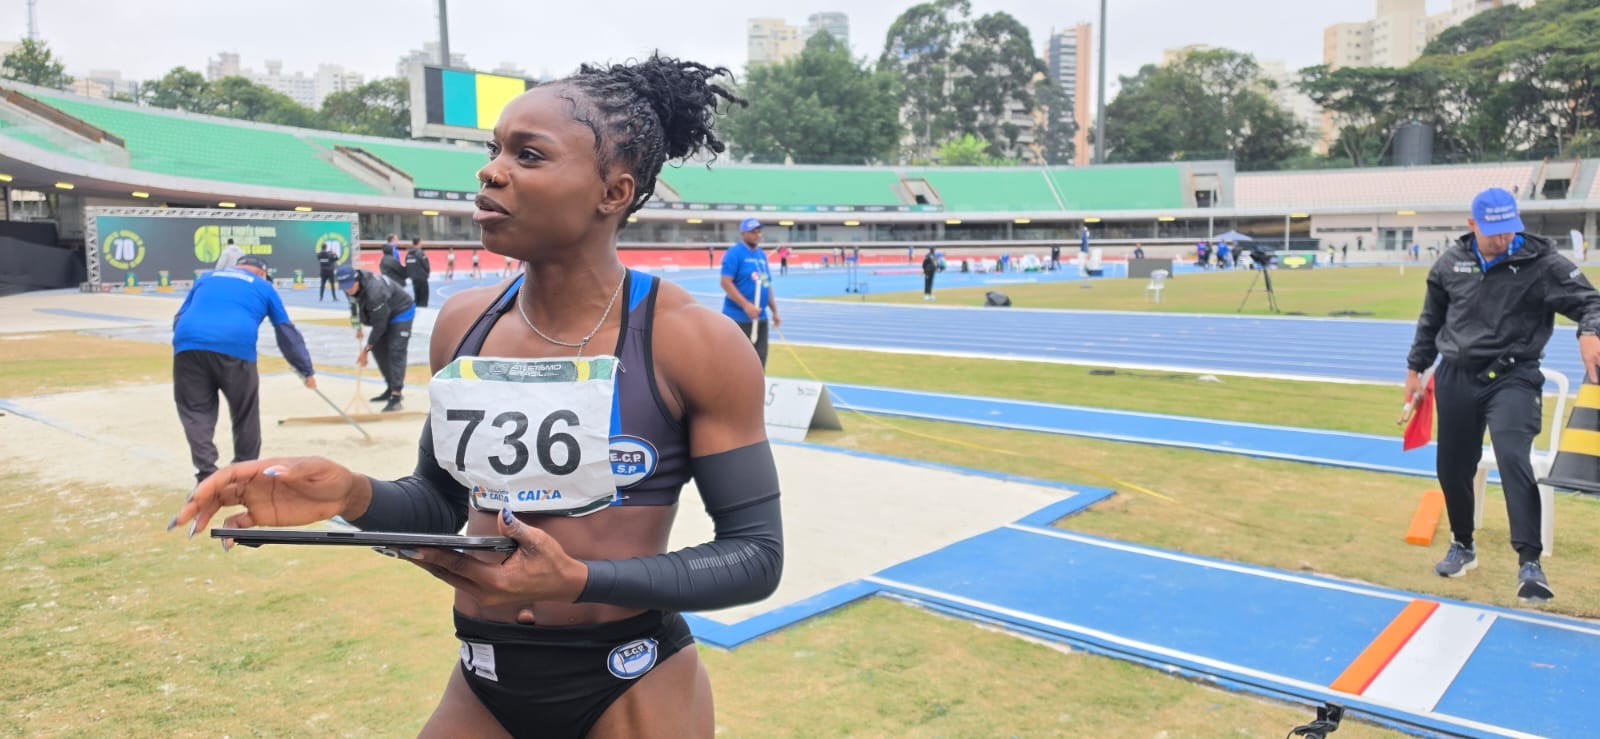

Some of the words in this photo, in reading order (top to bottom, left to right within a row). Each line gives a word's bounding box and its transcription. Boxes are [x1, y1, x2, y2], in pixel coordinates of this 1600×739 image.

[113, 239, 135, 261] 70
[447, 409, 581, 475] 736
[517, 489, 562, 502] CAIXA
